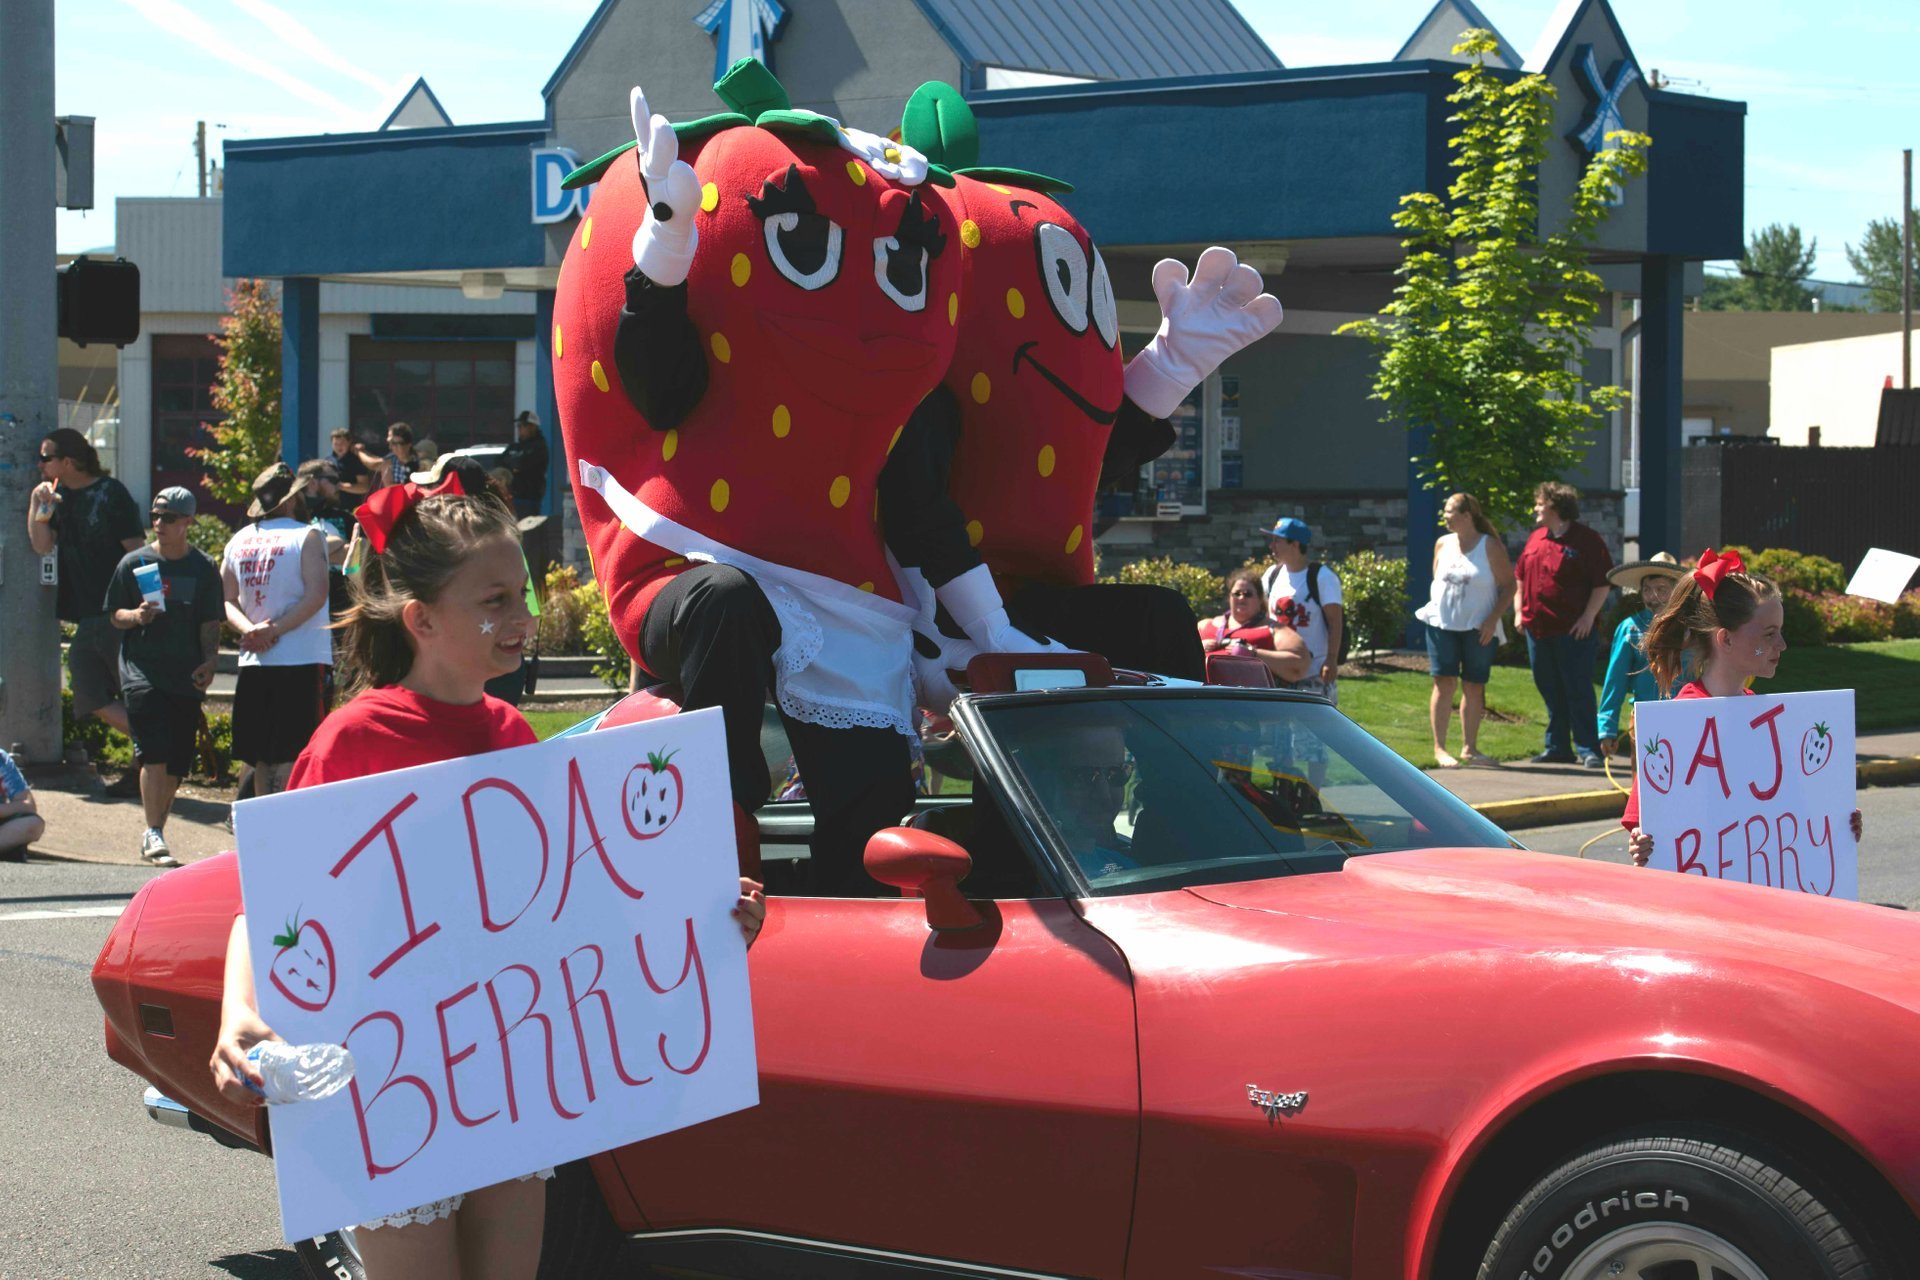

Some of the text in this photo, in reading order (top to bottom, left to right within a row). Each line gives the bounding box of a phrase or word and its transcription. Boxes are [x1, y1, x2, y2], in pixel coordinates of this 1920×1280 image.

[532, 147, 598, 224] D
[329, 757, 644, 980] IDA
[343, 918, 712, 1180] BERRY
[1519, 1189, 1690, 1280] oodrich
